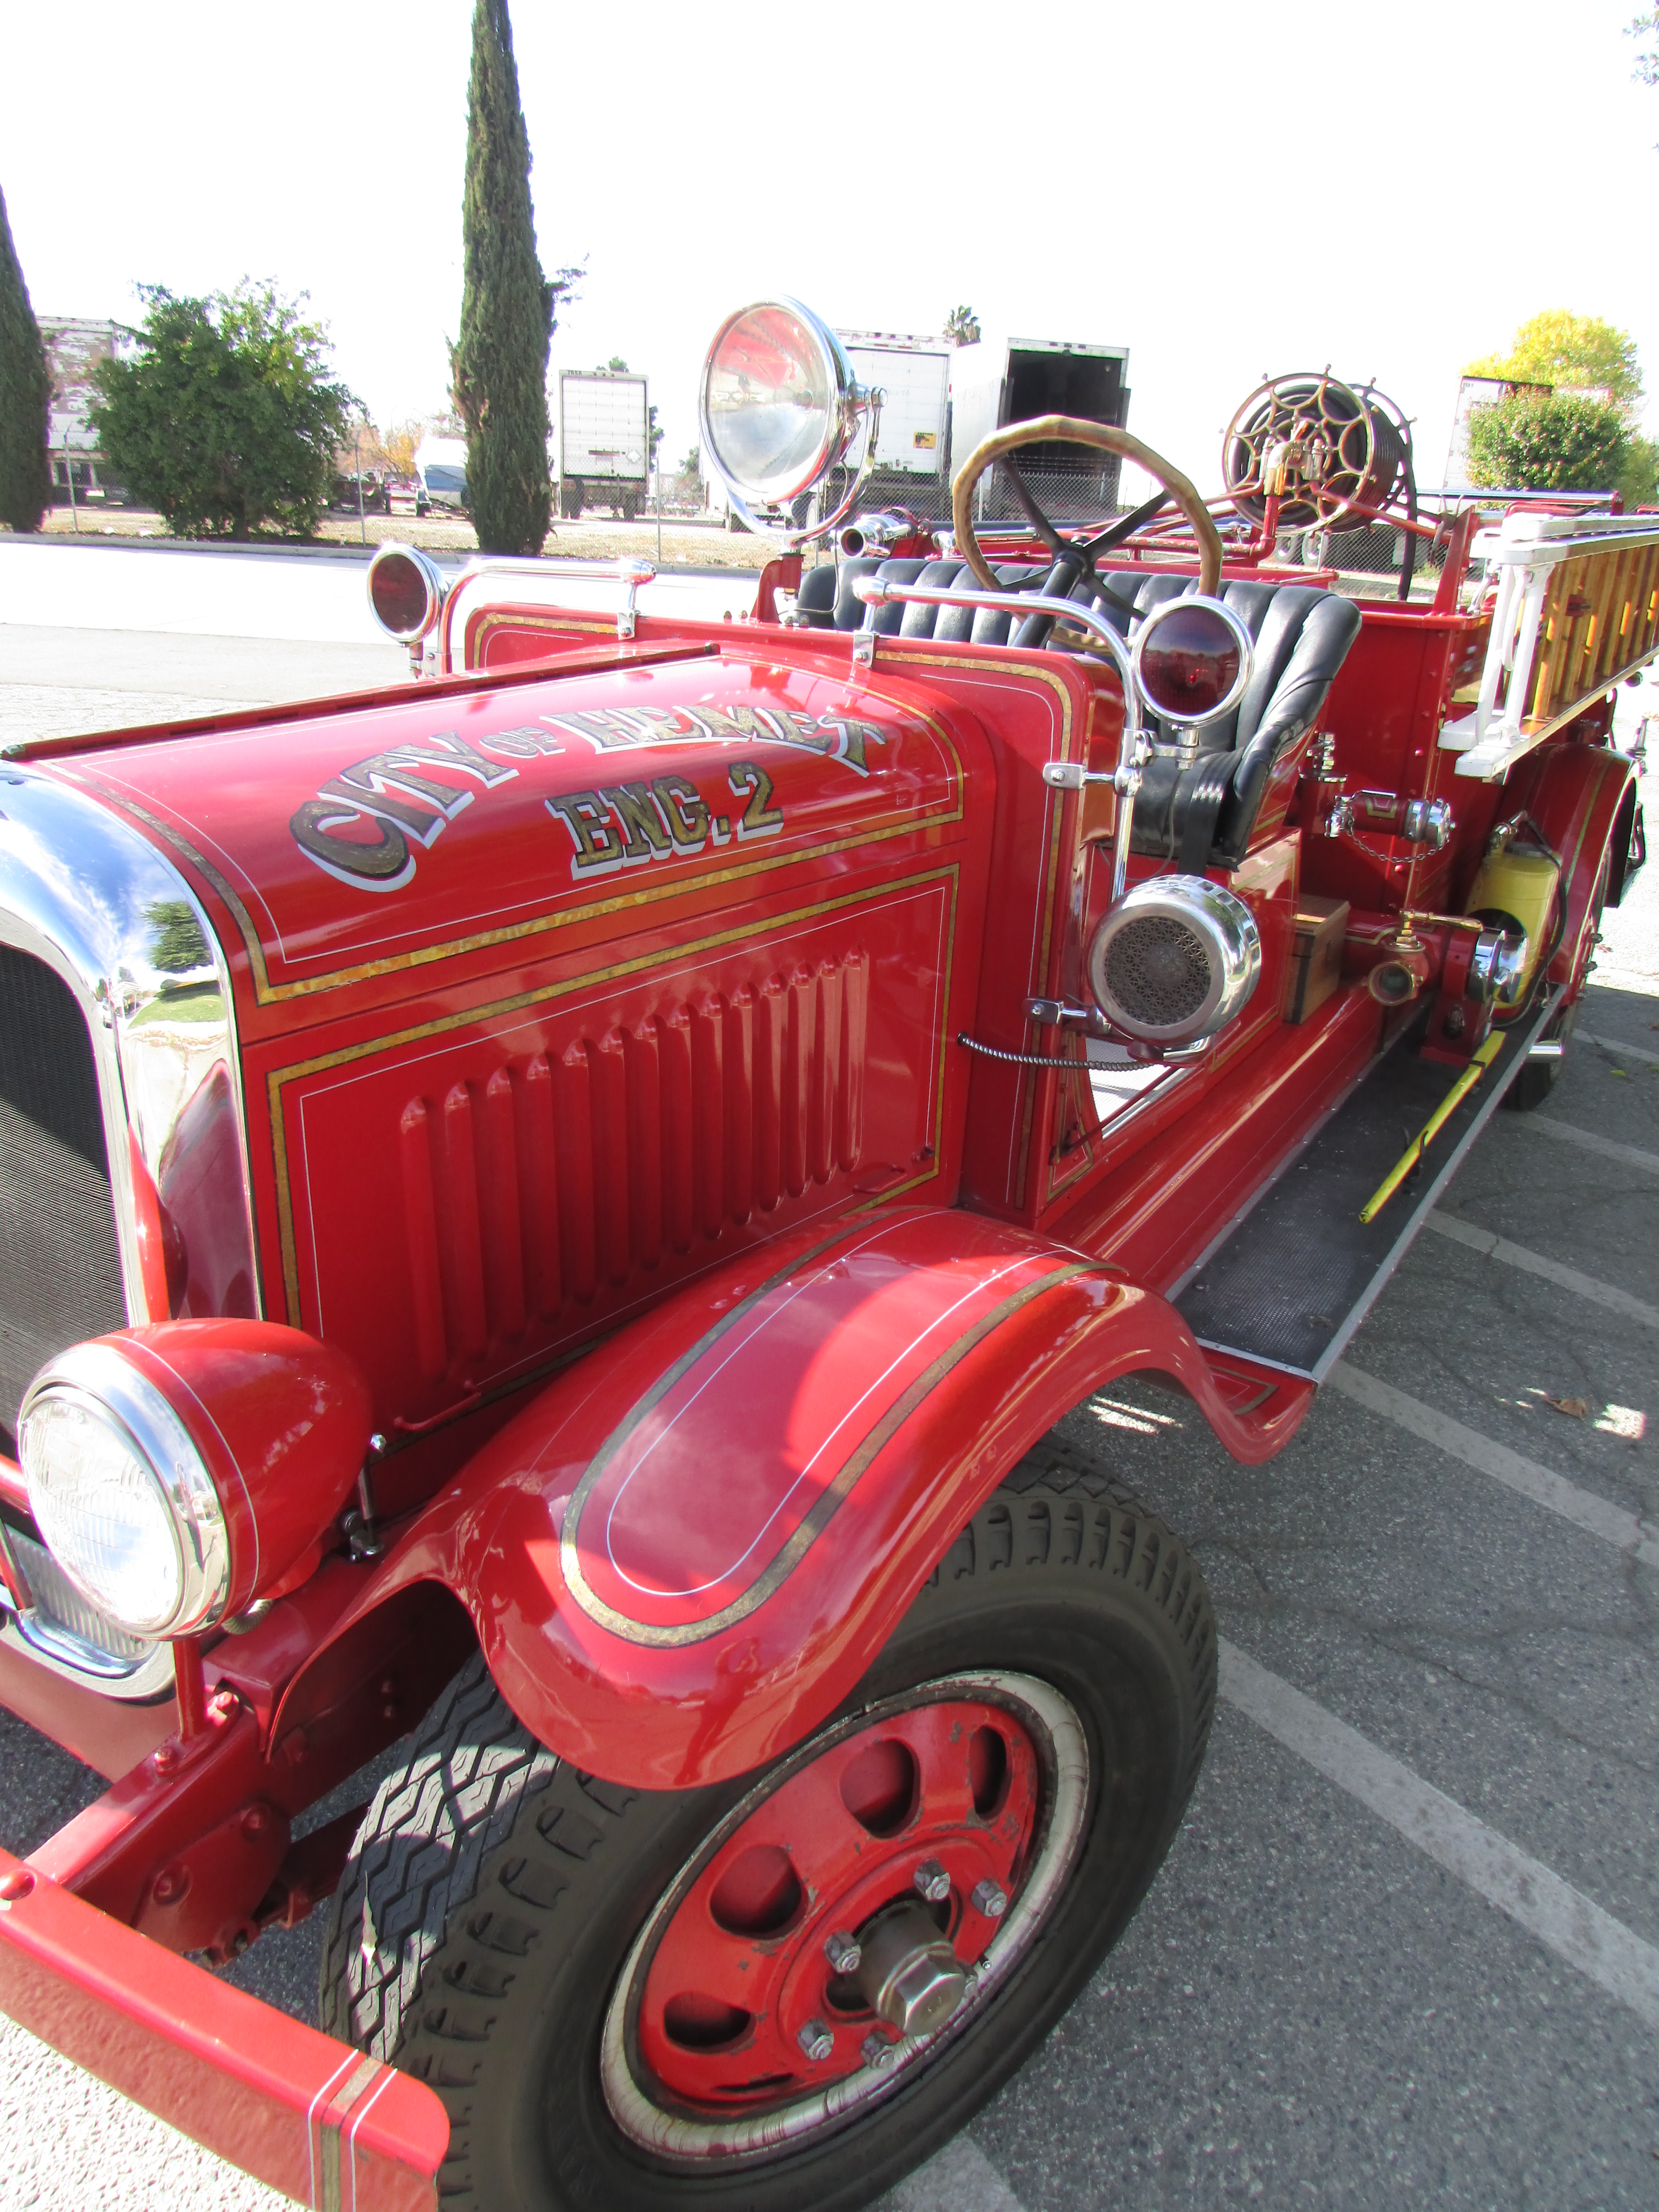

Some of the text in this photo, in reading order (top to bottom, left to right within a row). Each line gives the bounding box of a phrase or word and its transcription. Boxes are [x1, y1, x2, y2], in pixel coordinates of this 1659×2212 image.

[289, 705, 888, 893] CITY OF HEMET
